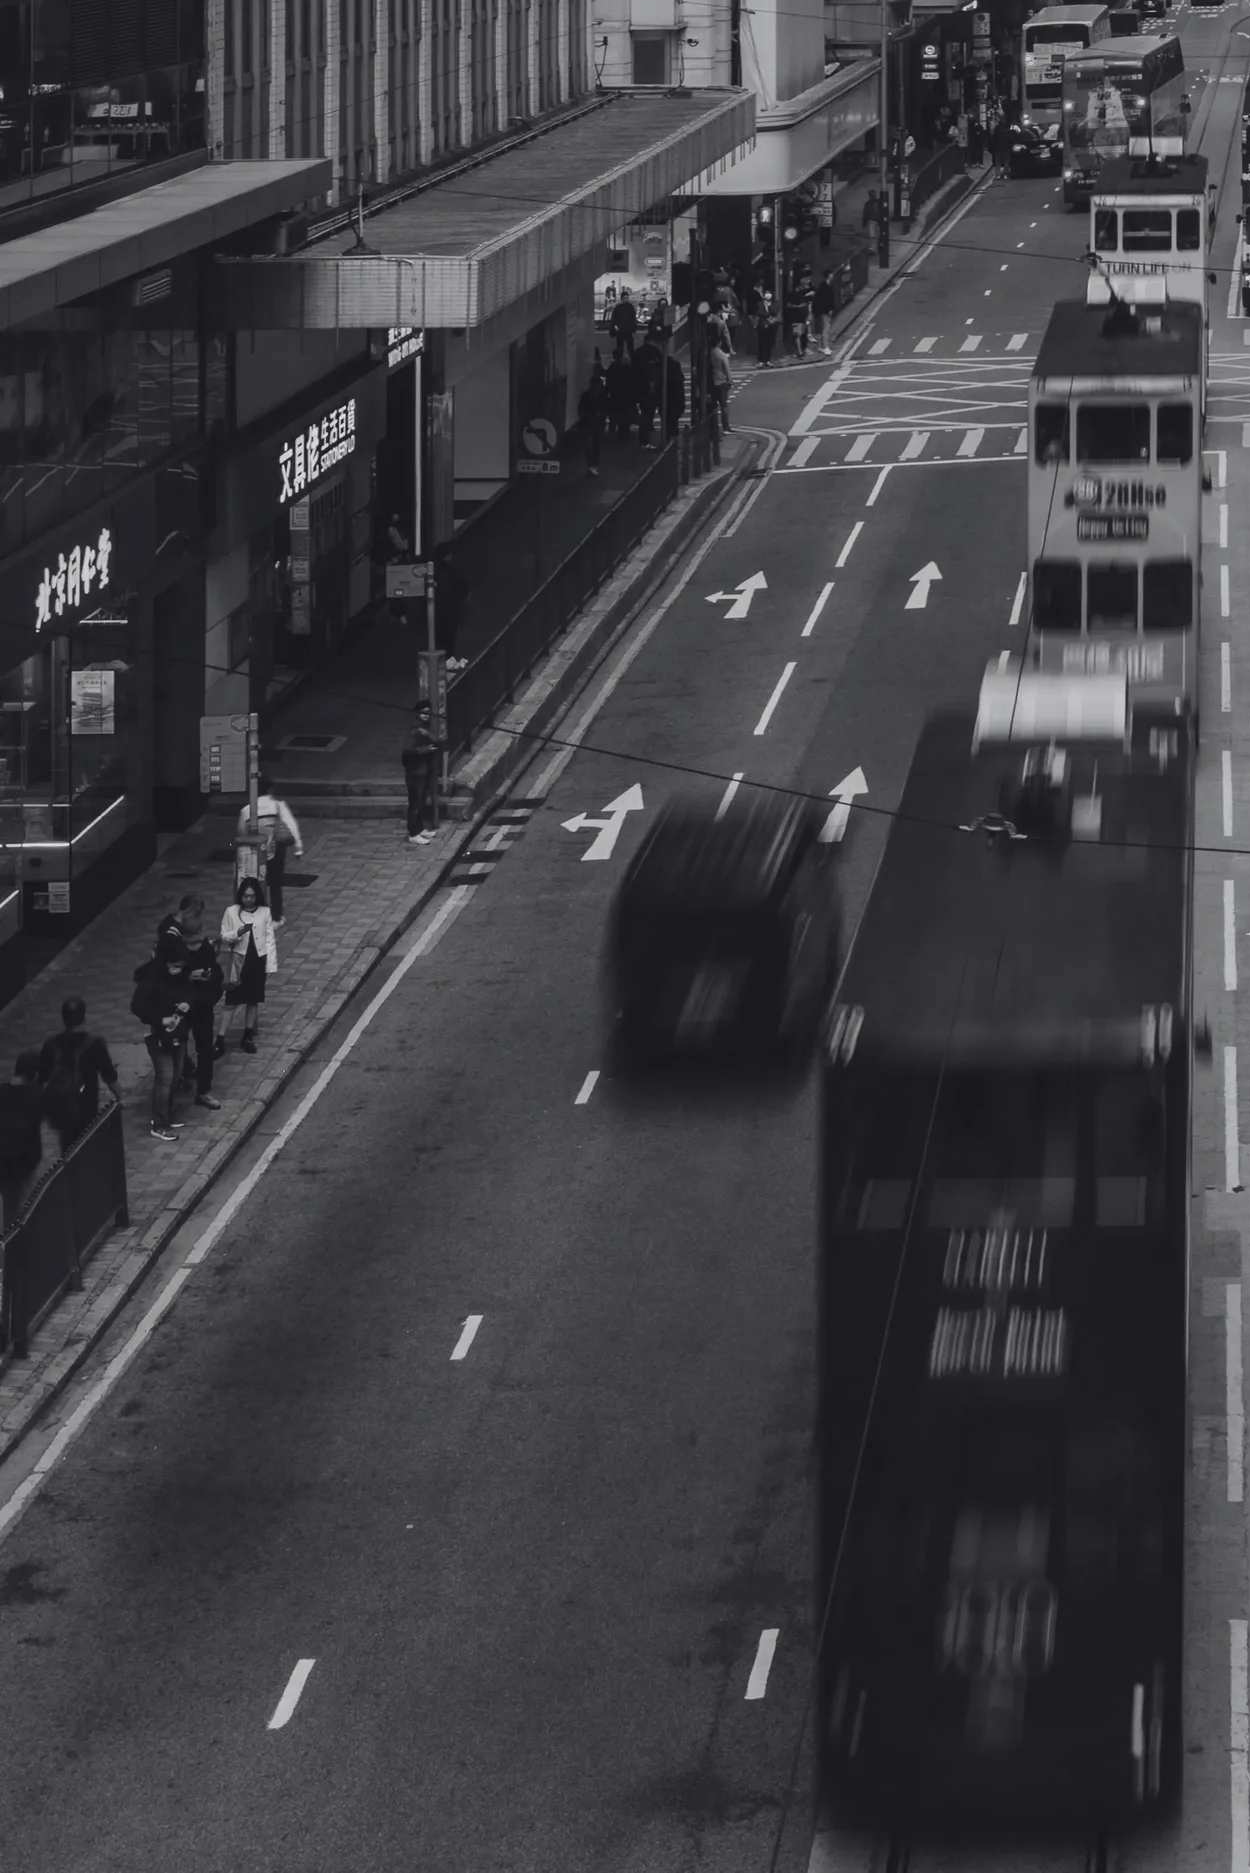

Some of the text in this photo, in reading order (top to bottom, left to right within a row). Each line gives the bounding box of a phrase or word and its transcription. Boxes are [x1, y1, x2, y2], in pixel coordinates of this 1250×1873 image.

[35, 528, 112, 633] 北京同仁堂
